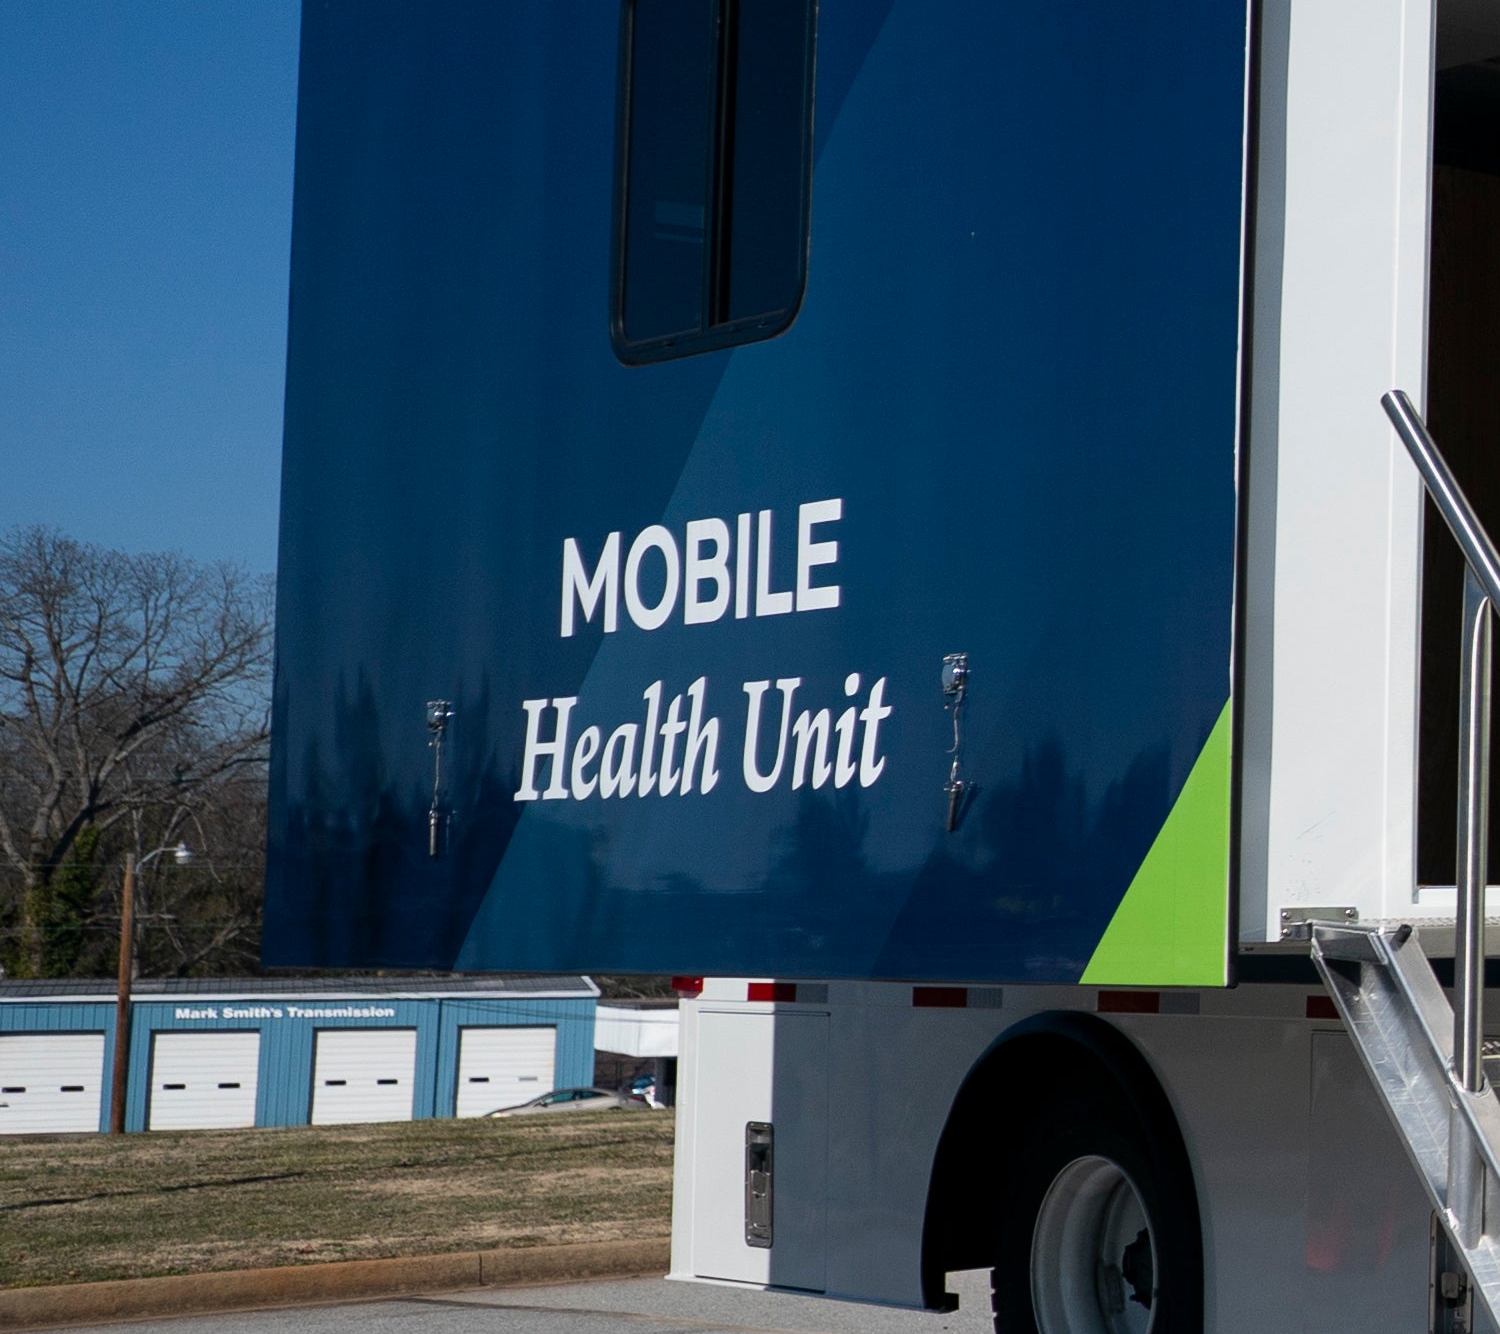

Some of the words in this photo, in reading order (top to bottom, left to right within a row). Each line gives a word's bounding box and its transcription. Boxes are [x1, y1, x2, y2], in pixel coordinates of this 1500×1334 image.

[560, 498, 842, 637] MOBILE
[513, 676, 719, 801] Health
[742, 672, 893, 794] Unit
[175, 1008, 217, 1020] Mark
[222, 1006, 283, 1019] Smith's
[286, 1006, 395, 1018] Transmission
